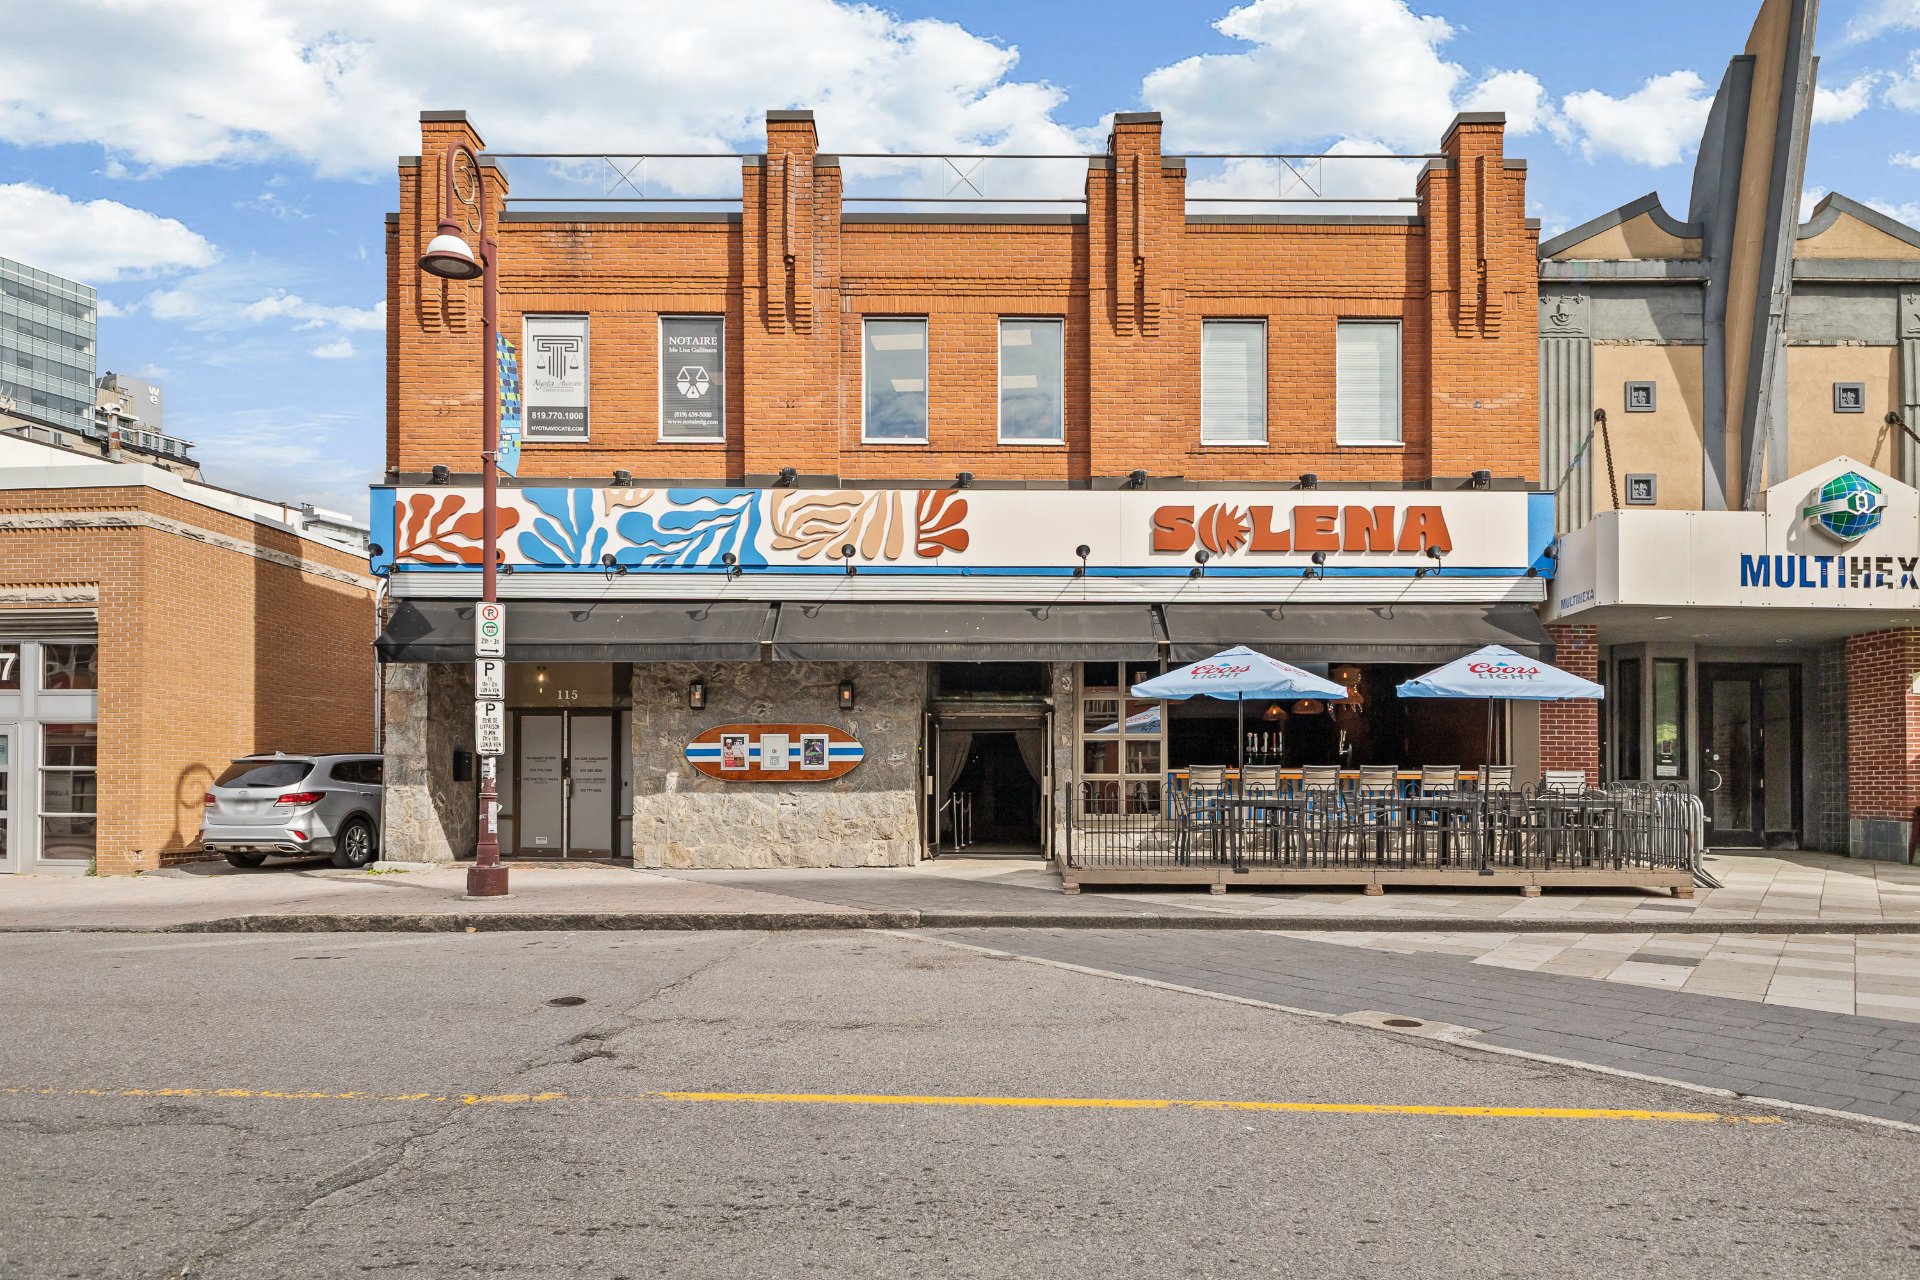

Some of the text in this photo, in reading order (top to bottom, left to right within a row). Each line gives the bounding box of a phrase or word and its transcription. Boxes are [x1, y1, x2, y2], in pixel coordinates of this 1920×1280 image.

[669, 336, 718, 345] NOTAIRE
[531, 411, 584, 420] 819.770.1000
[485, 662, 495, 676] P
[1191, 664, 1251, 675] Coors
[1467, 662, 1541, 674] Coors
[1191, 672, 1241, 680] LIGHT
[557, 689, 578, 700] 115
[486, 703, 496, 716] P
